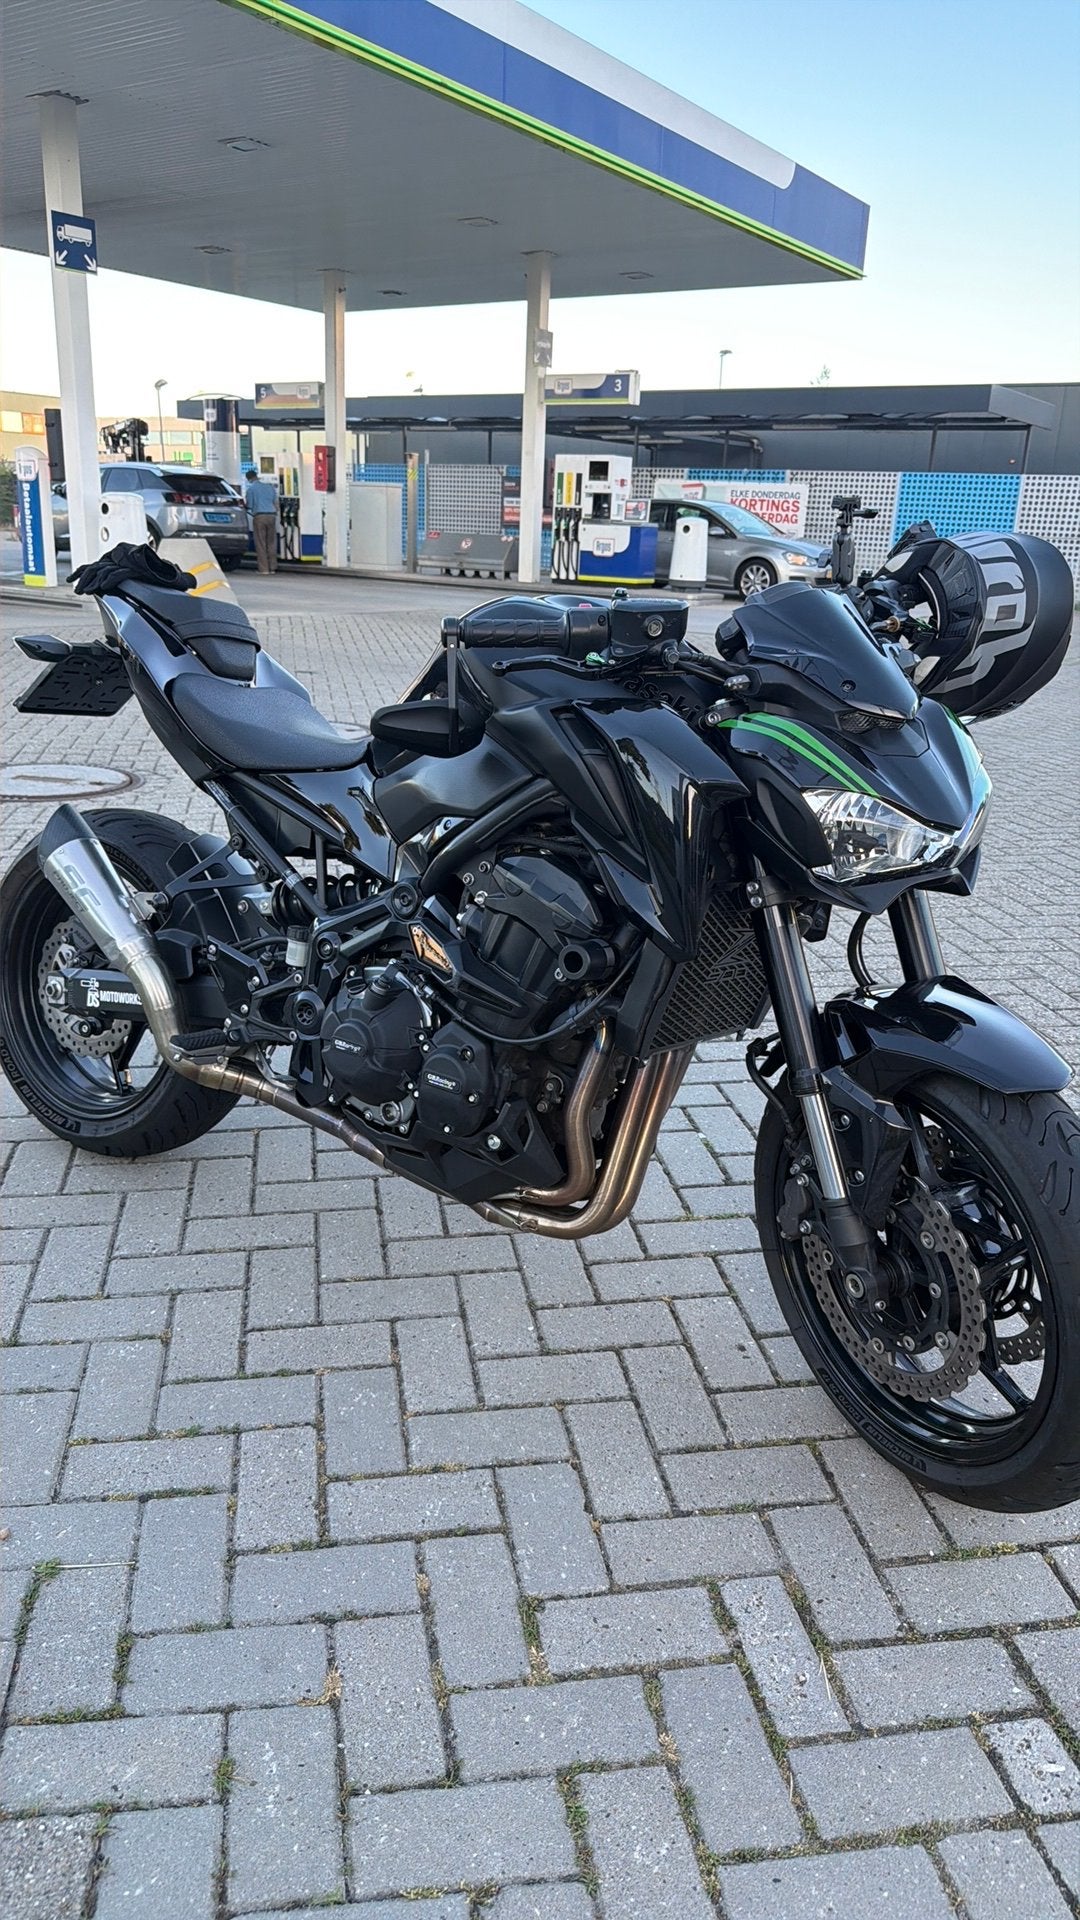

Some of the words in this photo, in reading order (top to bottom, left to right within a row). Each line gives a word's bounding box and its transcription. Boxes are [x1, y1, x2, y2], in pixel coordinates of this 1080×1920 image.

[260, 387, 266, 398] 5
[614, 379, 622, 392] 3
[730, 489, 750, 498] ELKE
[751, 490, 801, 500] DONDERDAG
[730, 498, 800, 513] KORTINGS
[622, 678, 700, 720] asaki
[100, 990, 143, 1006] MOTOWORKS
[1, 1049, 21, 1078] ROAD
[20, 1084, 66, 1124] MICHELIN
[866, 1424, 912, 1461] MICHELIN
